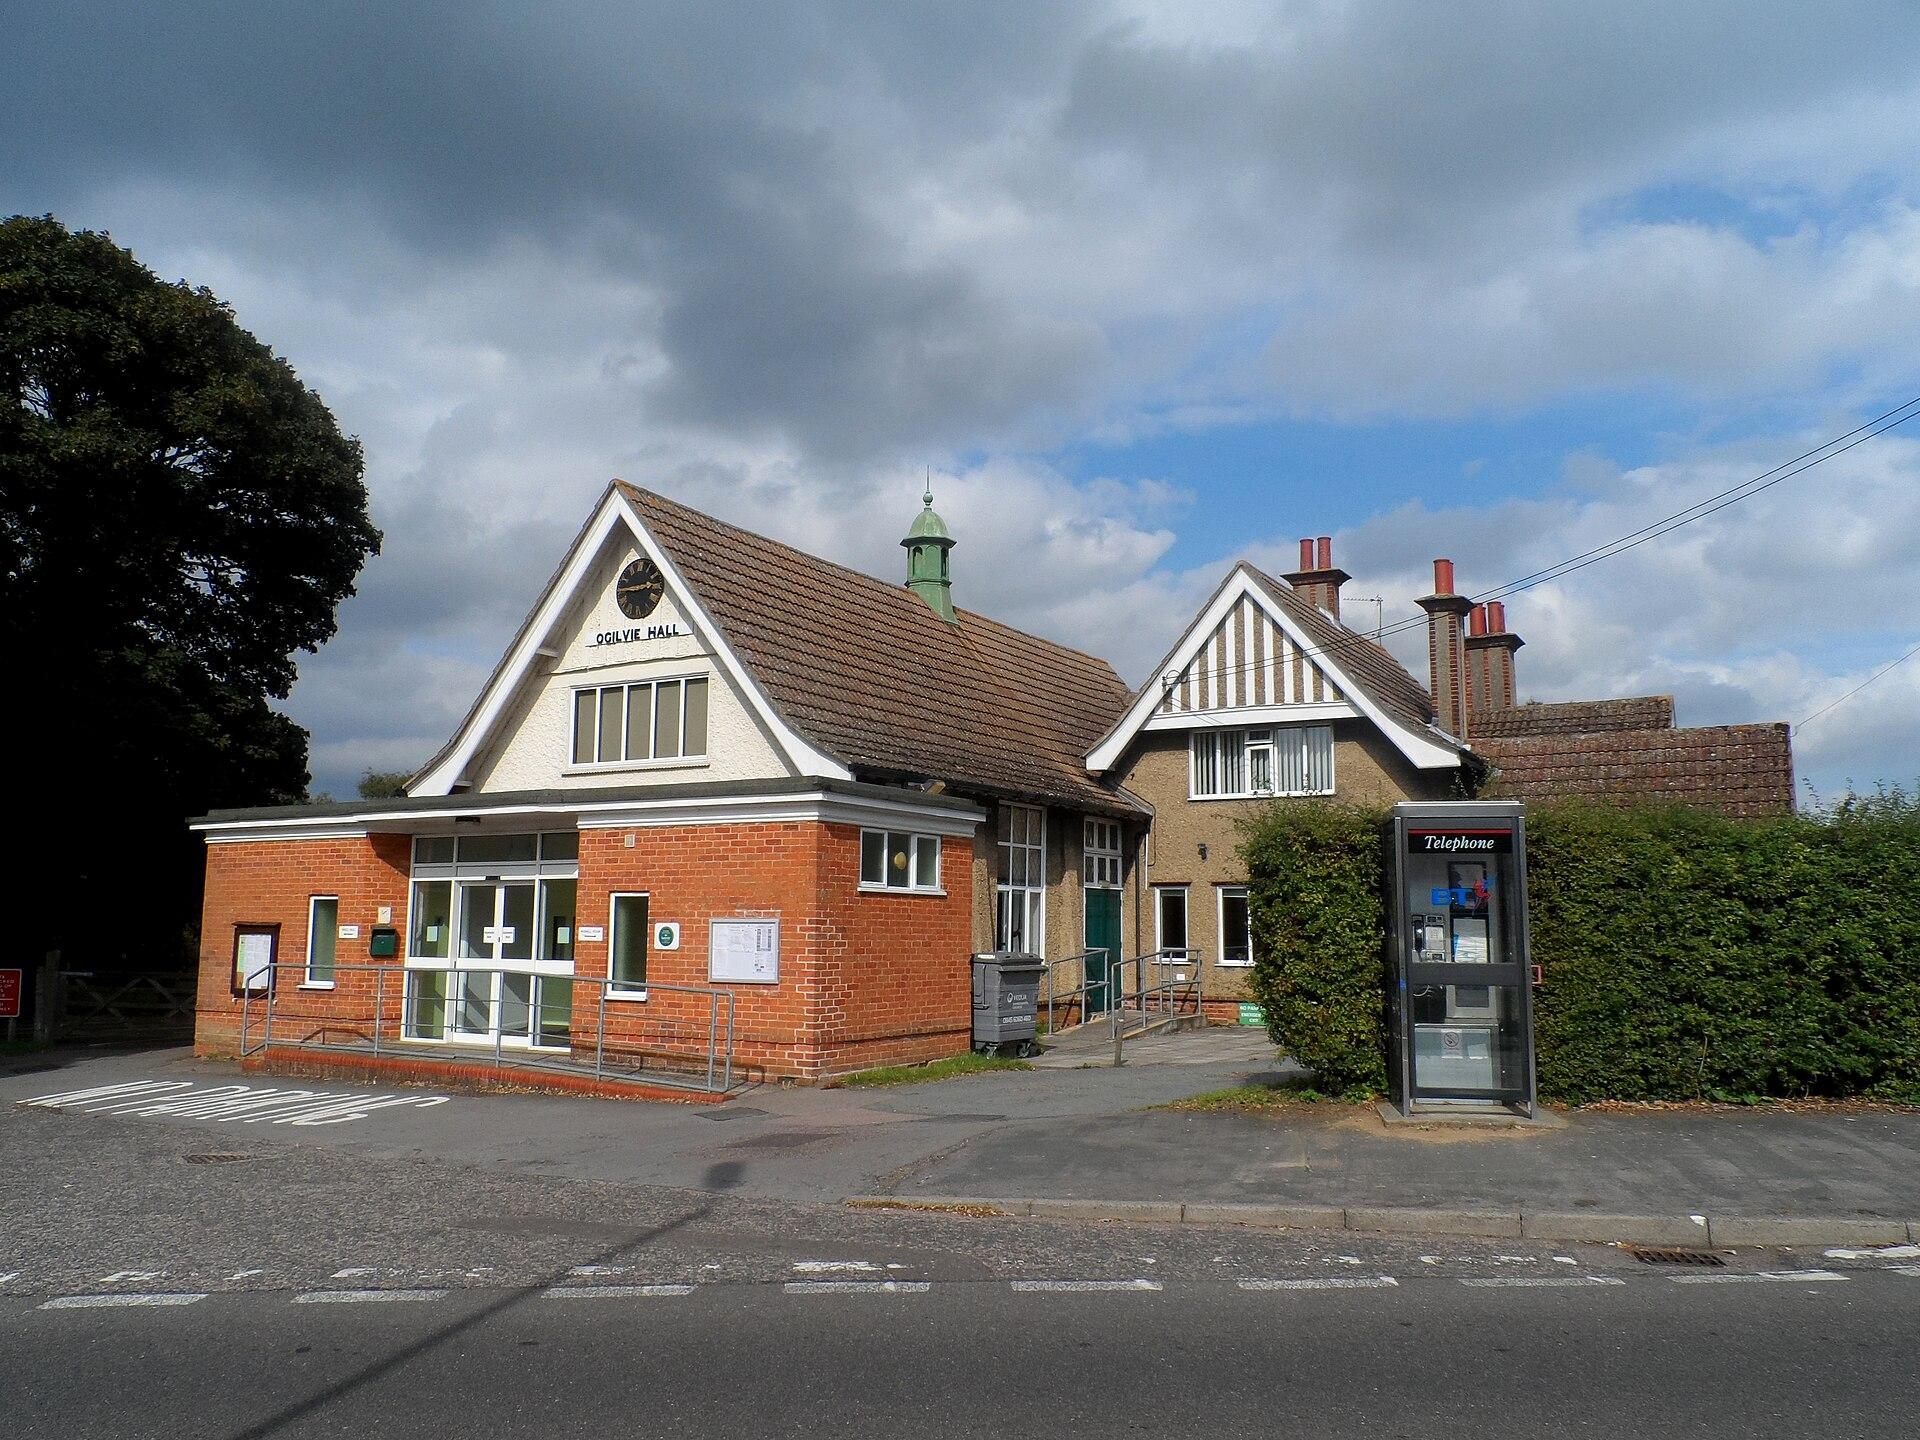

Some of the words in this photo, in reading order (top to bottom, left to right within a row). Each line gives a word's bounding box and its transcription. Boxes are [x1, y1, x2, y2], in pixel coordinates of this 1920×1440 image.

[596, 629, 641, 645] OGILVIE
[647, 623, 680, 639] HALL
[1424, 835, 1495, 852] Telephone
[84, 1084, 452, 1126] PARKING
